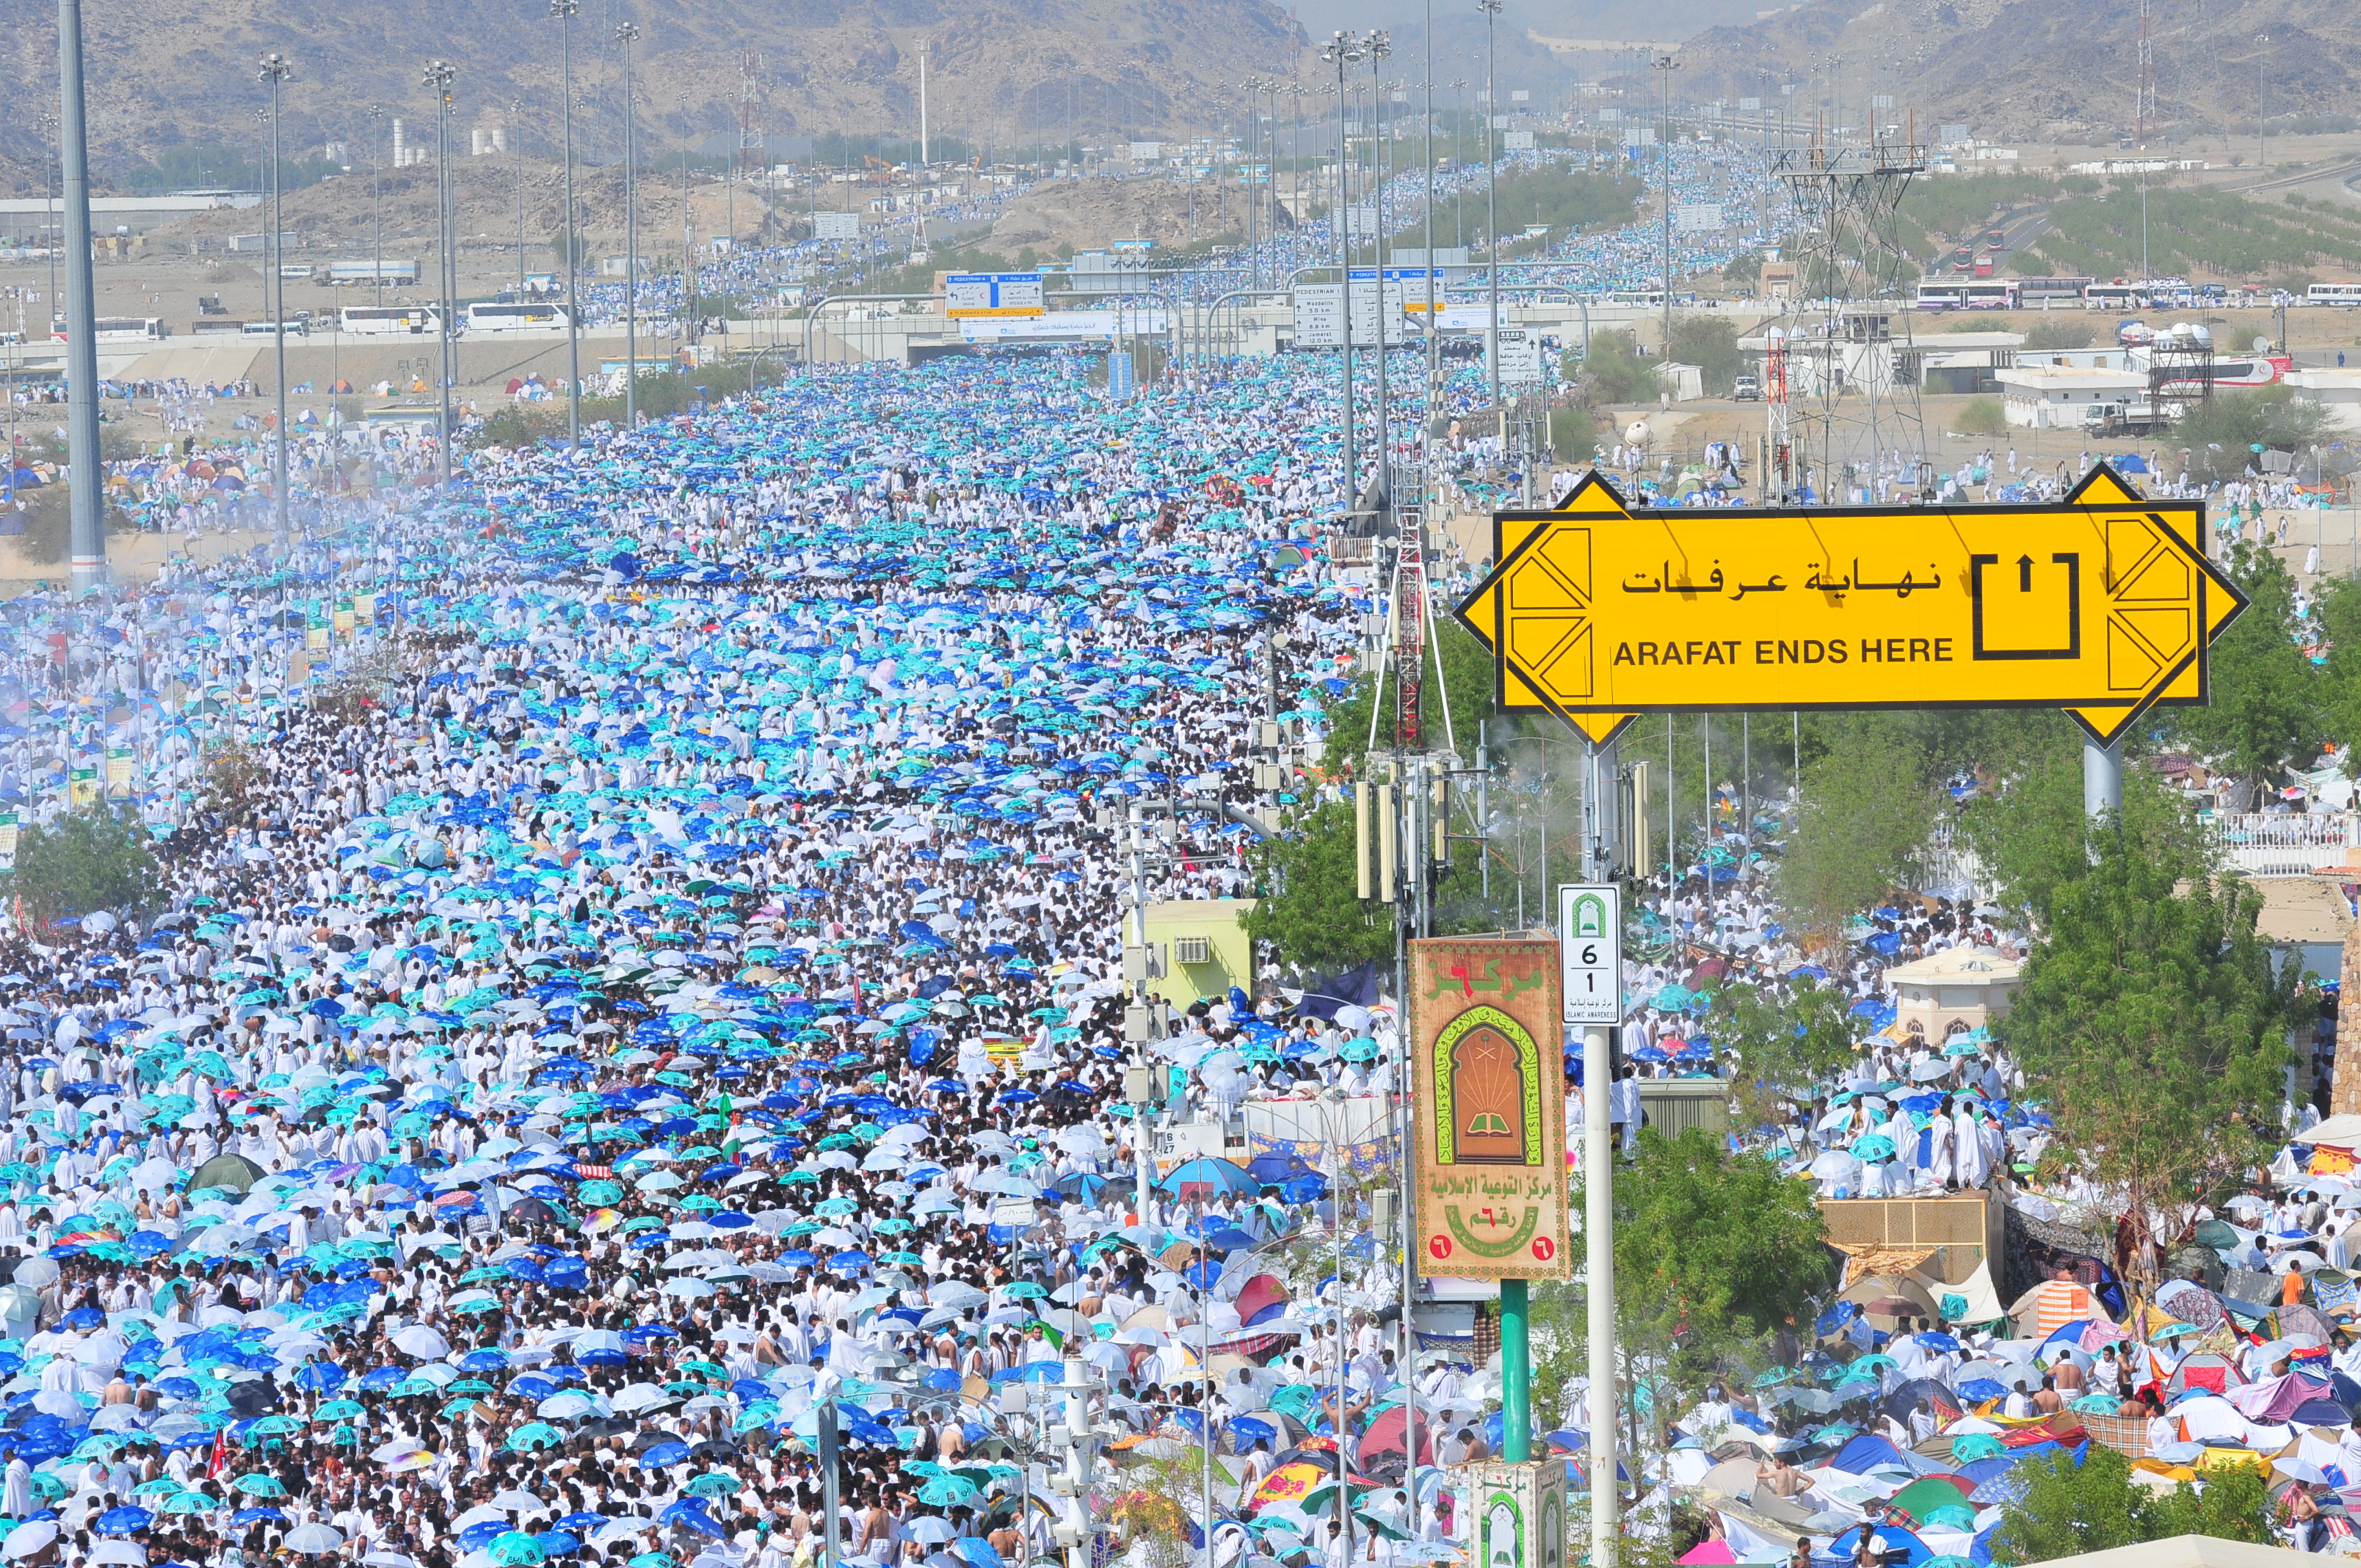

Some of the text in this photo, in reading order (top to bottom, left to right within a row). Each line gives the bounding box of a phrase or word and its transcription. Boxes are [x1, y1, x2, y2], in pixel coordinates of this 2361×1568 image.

[1622, 556, 1941, 600] نهاية عرفات
[1614, 637, 1953, 666] ARAFAT ENDS HERE
[1582, 944, 1597, 964] 6
[1423, 958, 1542, 1001] مركز
[1586, 973, 1594, 992] 1
[1570, 998, 1612, 1009] مركز توعية إسلامية
[1164, 1145, 1175, 1154] 27
[1429, 1173, 1552, 1200] مركز التوعية الإسلامية
[1470, 1206, 1517, 1229] رقم
[1481, 1208, 1496, 1228] ٦
[1433, 1238, 1448, 1257] ٦
[1535, 1240, 1550, 1259] ٦
[746, 1418, 758, 1426] زين
[84, 1445, 99, 1455] زين
[247, 1484, 261, 1492] زين
[926, 1494, 940, 1503] زين
[507, 1554, 524, 1564] زين
